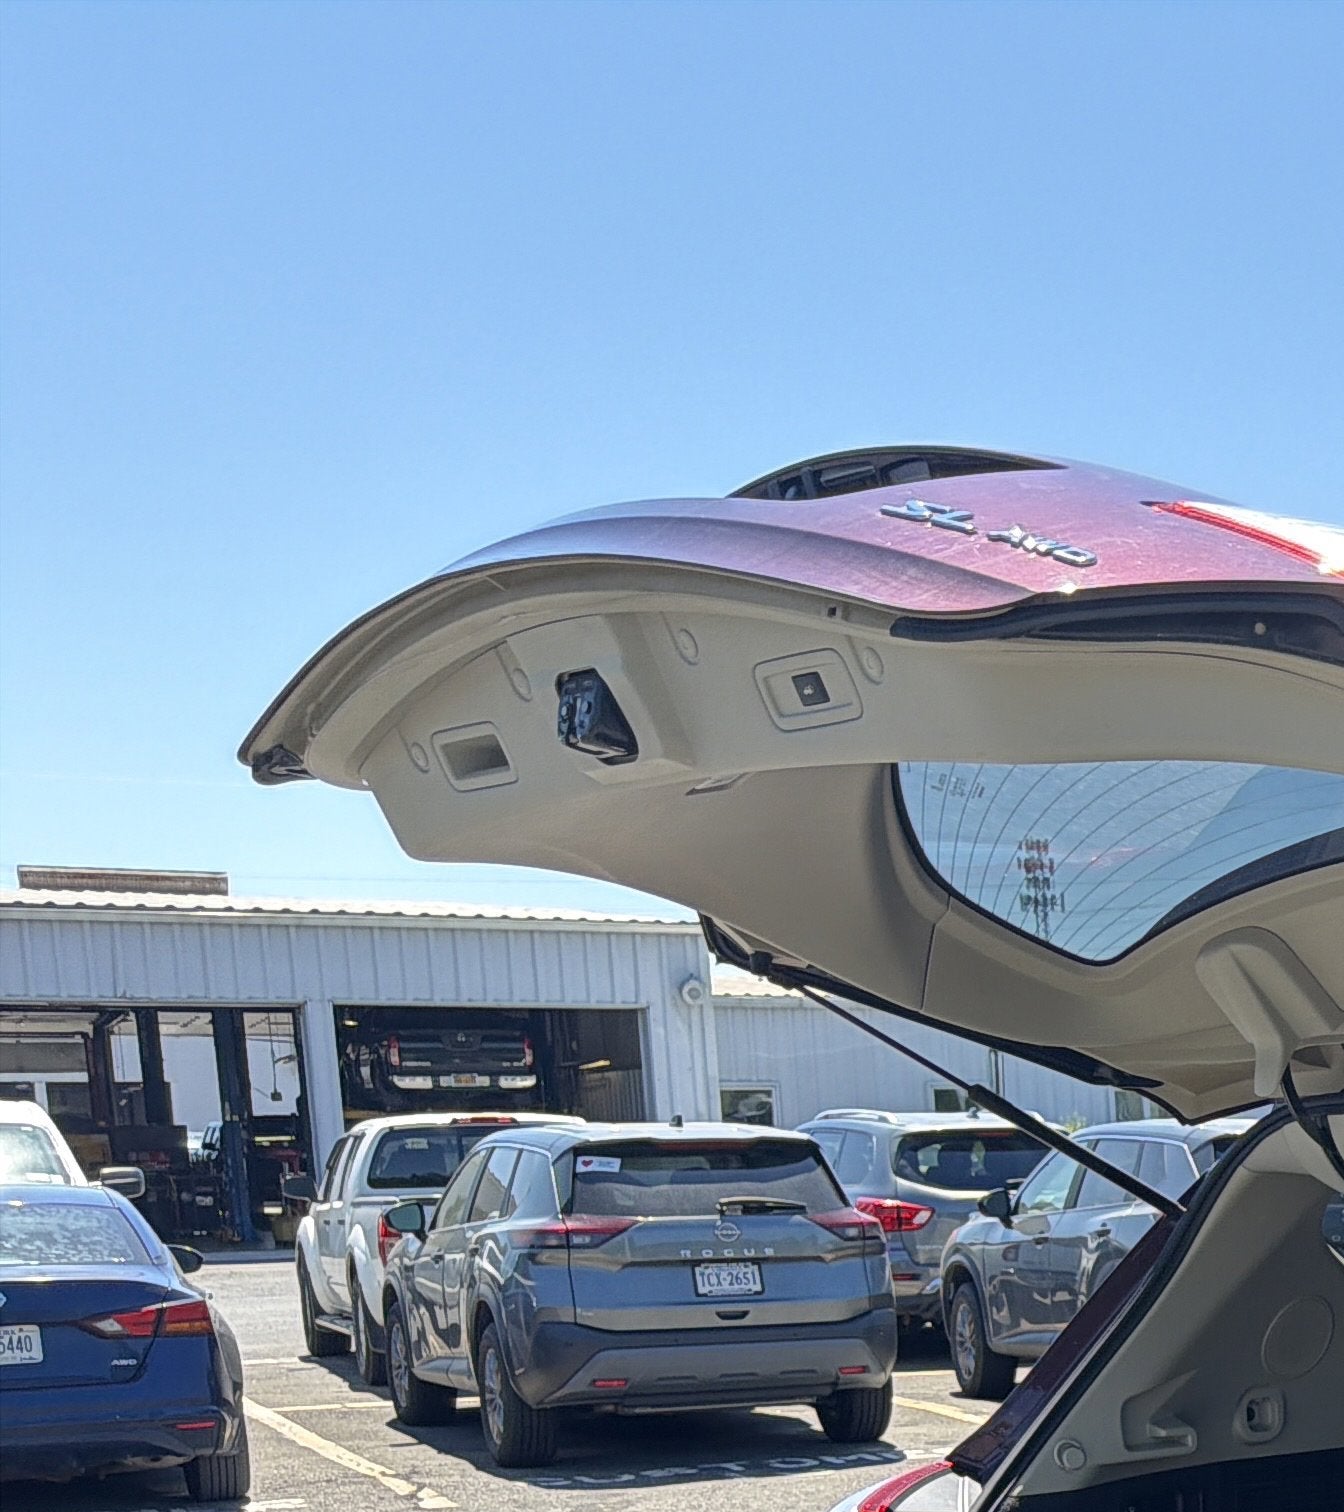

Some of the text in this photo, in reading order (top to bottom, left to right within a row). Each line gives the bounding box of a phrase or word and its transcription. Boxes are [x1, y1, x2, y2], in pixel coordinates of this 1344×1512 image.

[986, 524, 1099, 568] AWD
[680, 1247, 775, 1258] ROGUE
[698, 1271, 758, 1288] TCX-2651
[110, 1358, 138, 1367] AWD
